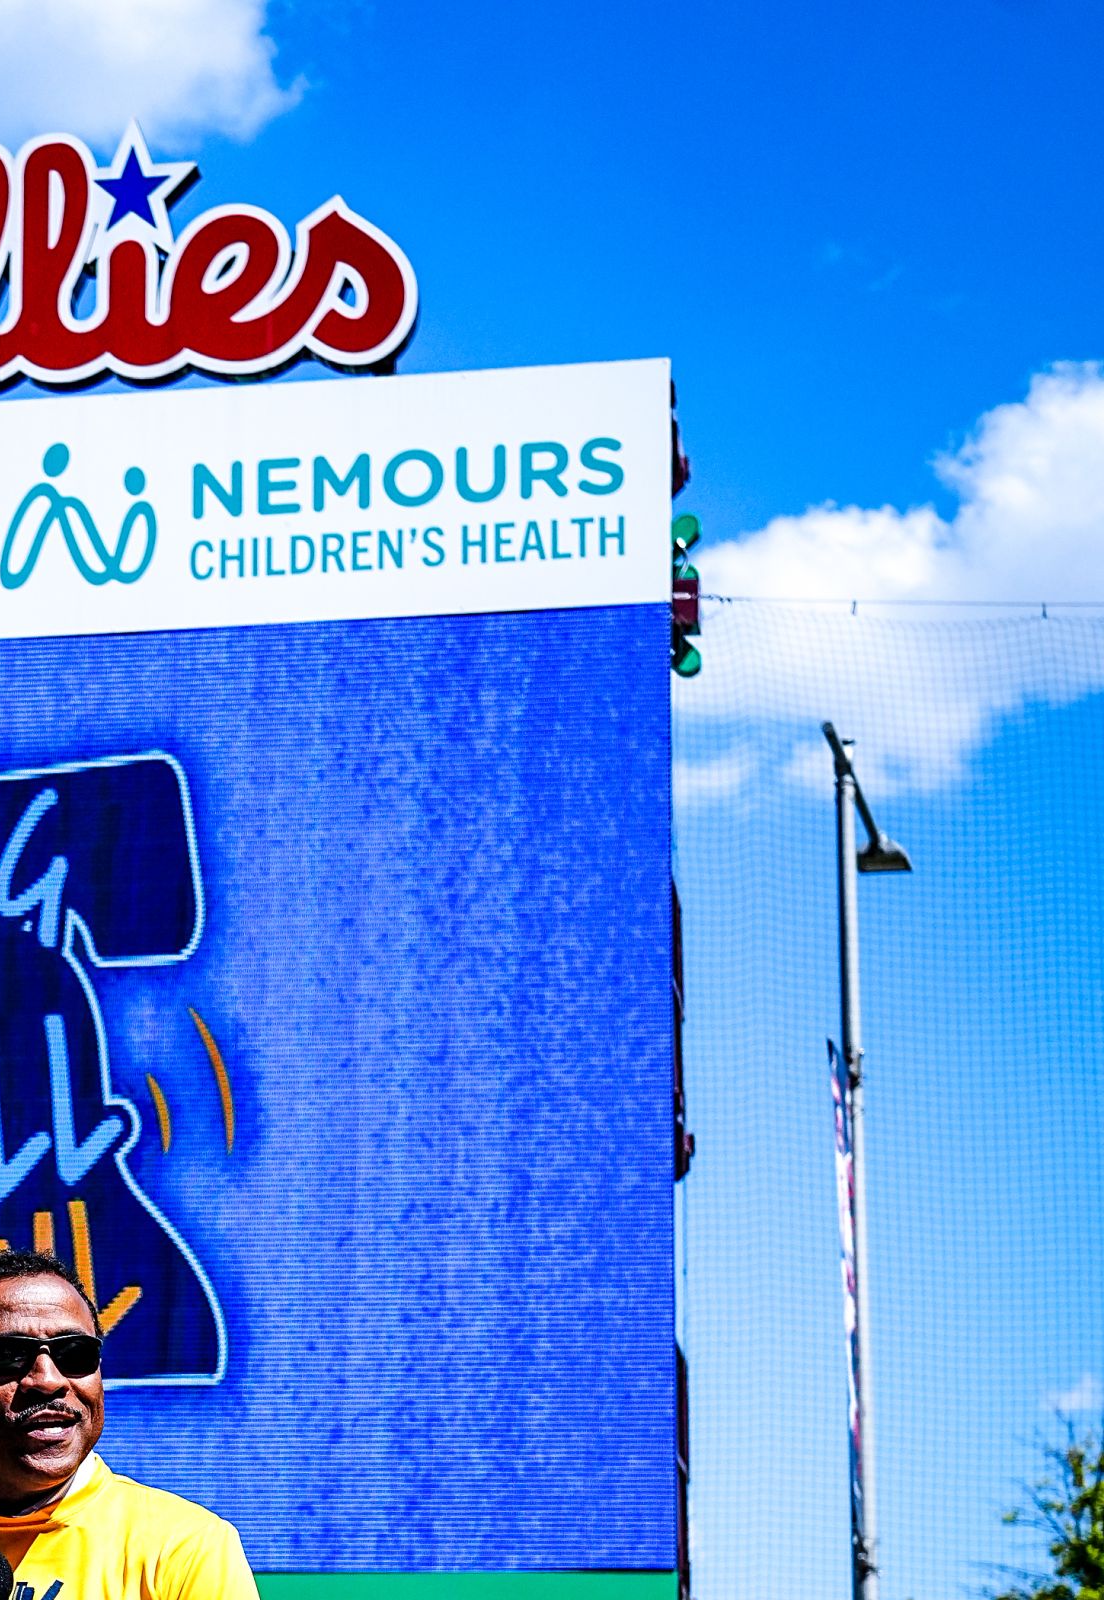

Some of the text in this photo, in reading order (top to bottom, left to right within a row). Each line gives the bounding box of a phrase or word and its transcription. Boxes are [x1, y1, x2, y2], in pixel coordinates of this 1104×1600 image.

[191, 436, 625, 520] NEMOURS
[189, 515, 626, 581] CHILDREN'S HEALTH
